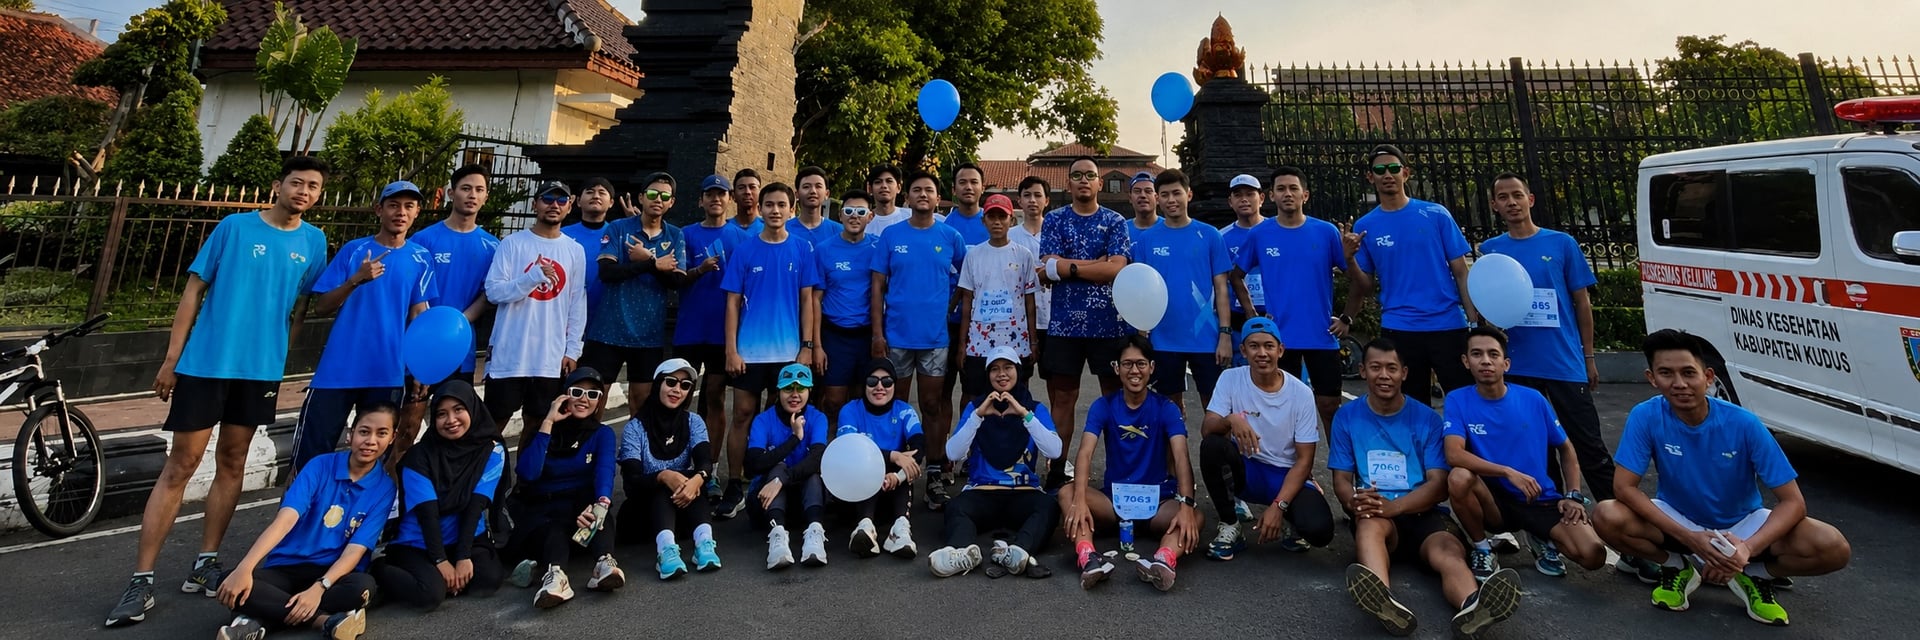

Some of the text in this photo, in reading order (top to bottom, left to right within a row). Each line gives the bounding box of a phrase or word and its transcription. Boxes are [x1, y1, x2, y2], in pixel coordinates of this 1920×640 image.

[1681, 266, 1718, 290] KELILING
[1730, 306, 1841, 342] DINAS KESEHATAN
[1733, 332, 1852, 373] KABUPATEN KUDUS
[1123, 495, 1152, 504] 7063
